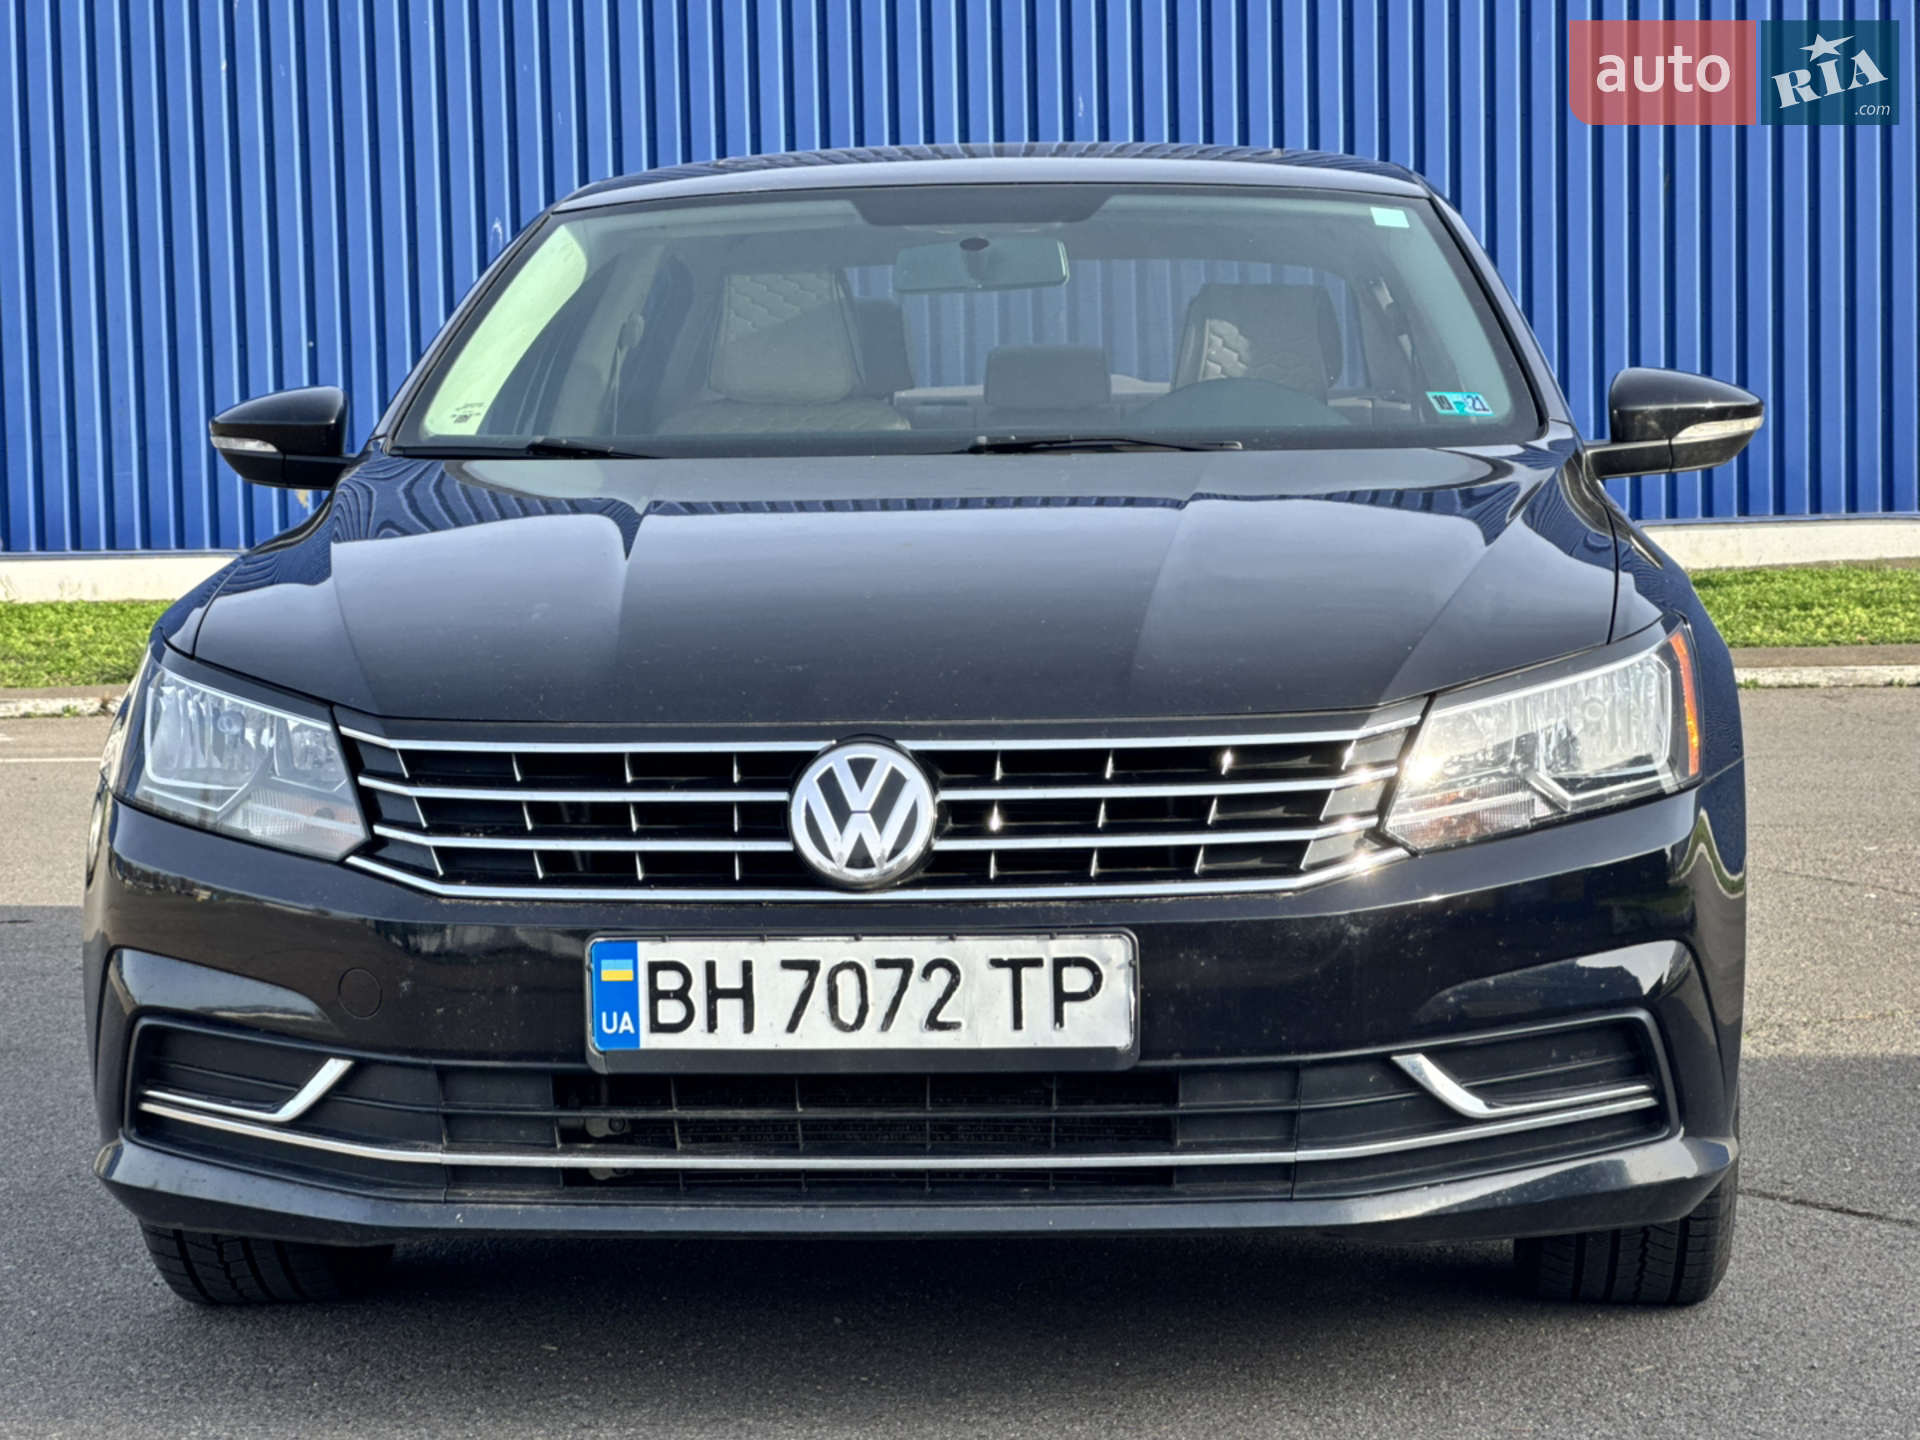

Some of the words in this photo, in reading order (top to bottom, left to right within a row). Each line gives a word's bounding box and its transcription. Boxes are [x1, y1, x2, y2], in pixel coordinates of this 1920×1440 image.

[1466, 395, 1490, 412] 21
[647, 959, 756, 1034] BH
[780, 957, 963, 1033] 7072
[988, 956, 1104, 1031] TP
[601, 1011, 636, 1035] UA
